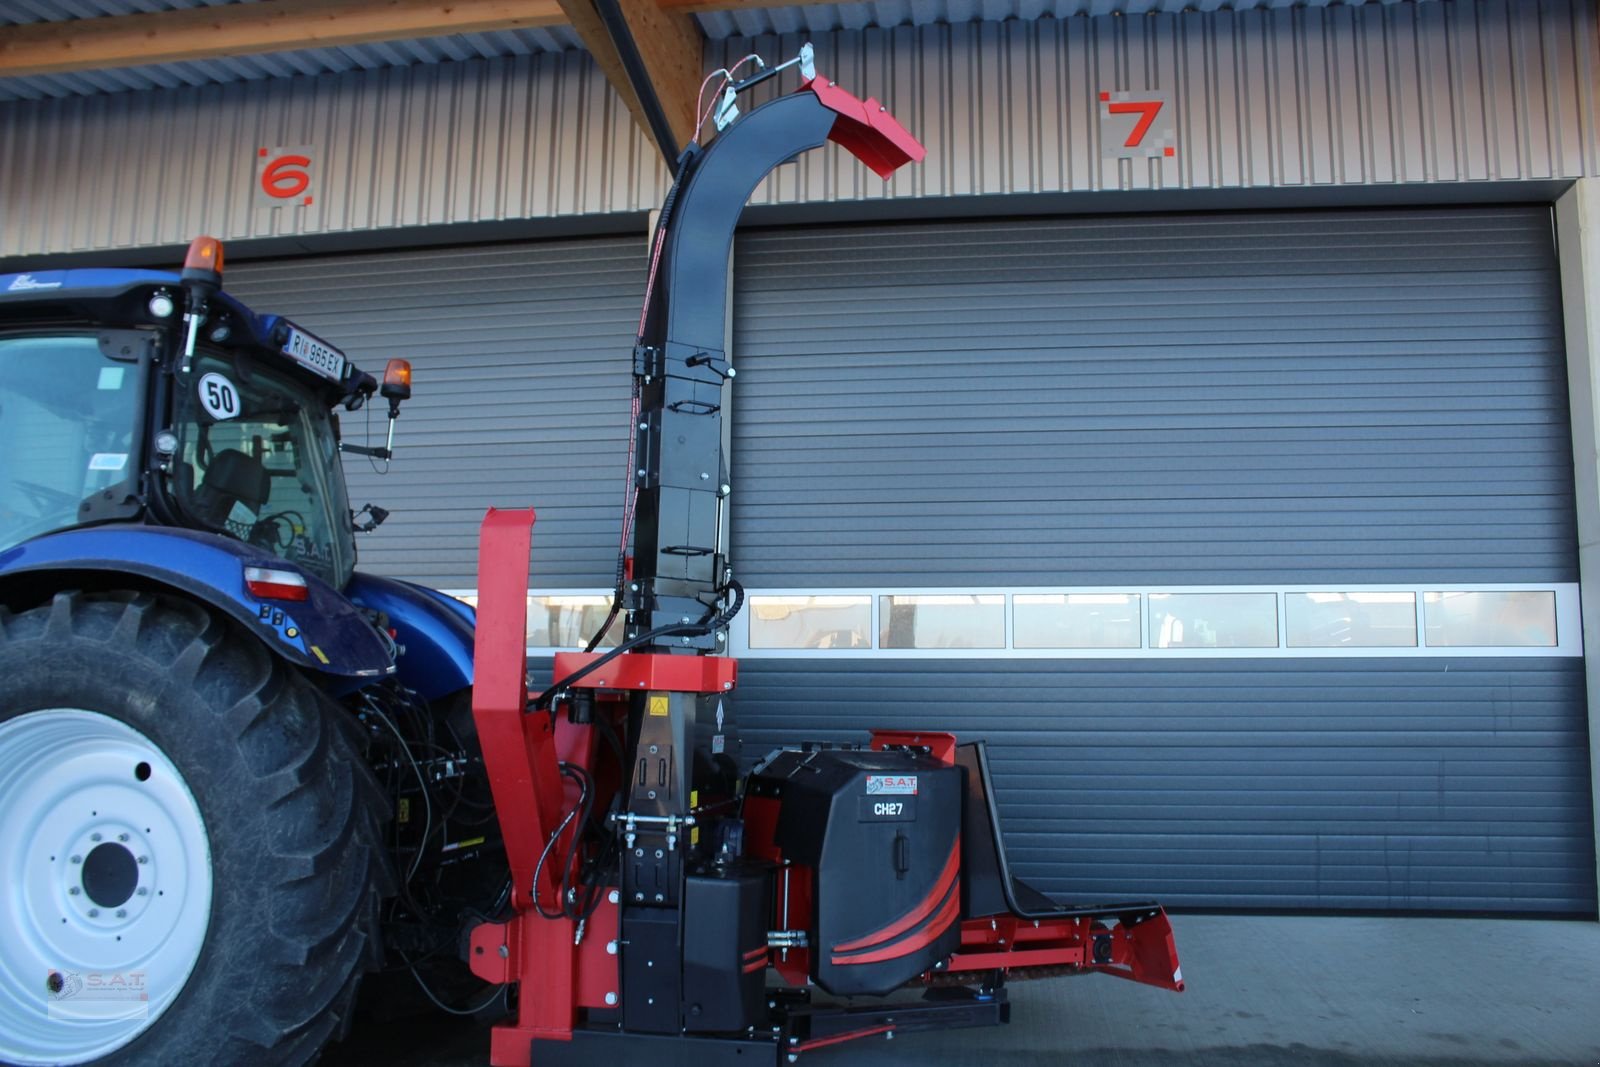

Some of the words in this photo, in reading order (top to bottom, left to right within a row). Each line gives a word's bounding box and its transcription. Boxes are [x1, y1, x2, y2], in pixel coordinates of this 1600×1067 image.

[1109, 102, 1164, 147] 7
[262, 155, 311, 198] 6
[207, 381, 234, 413] 50
[874, 803, 903, 815] CH27
